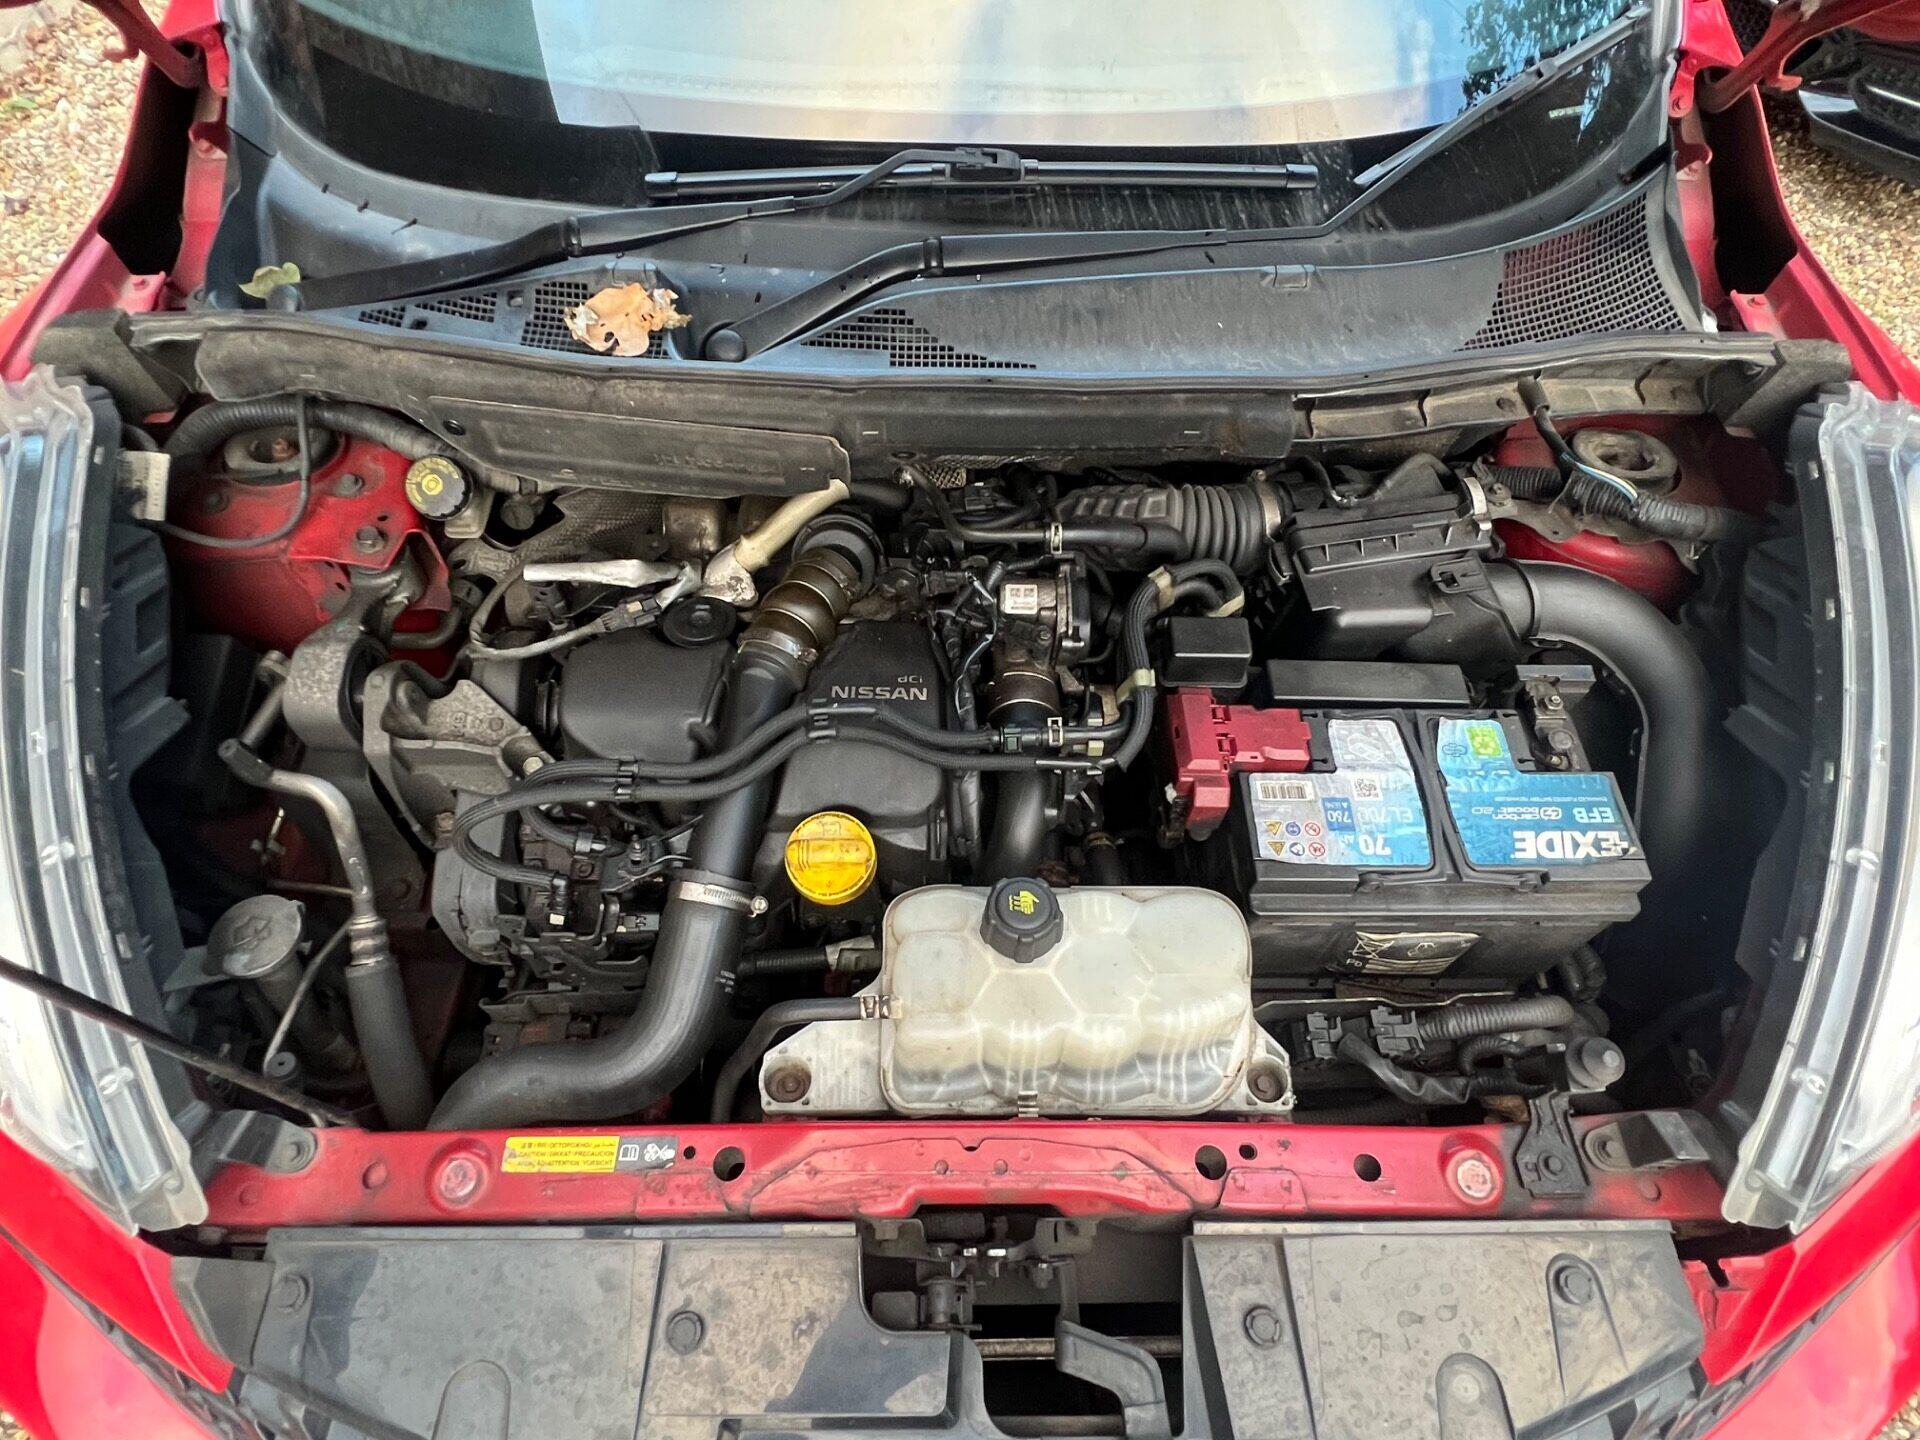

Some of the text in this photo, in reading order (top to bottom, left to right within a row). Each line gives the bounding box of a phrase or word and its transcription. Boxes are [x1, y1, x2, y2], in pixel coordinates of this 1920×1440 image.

[897, 675, 923, 684] dCi
[831, 685, 928, 701] NISSAN
[1572, 806, 1615, 824] EFB
[1358, 833, 1392, 856] 70
[1512, 830, 1629, 859] EXIDE
